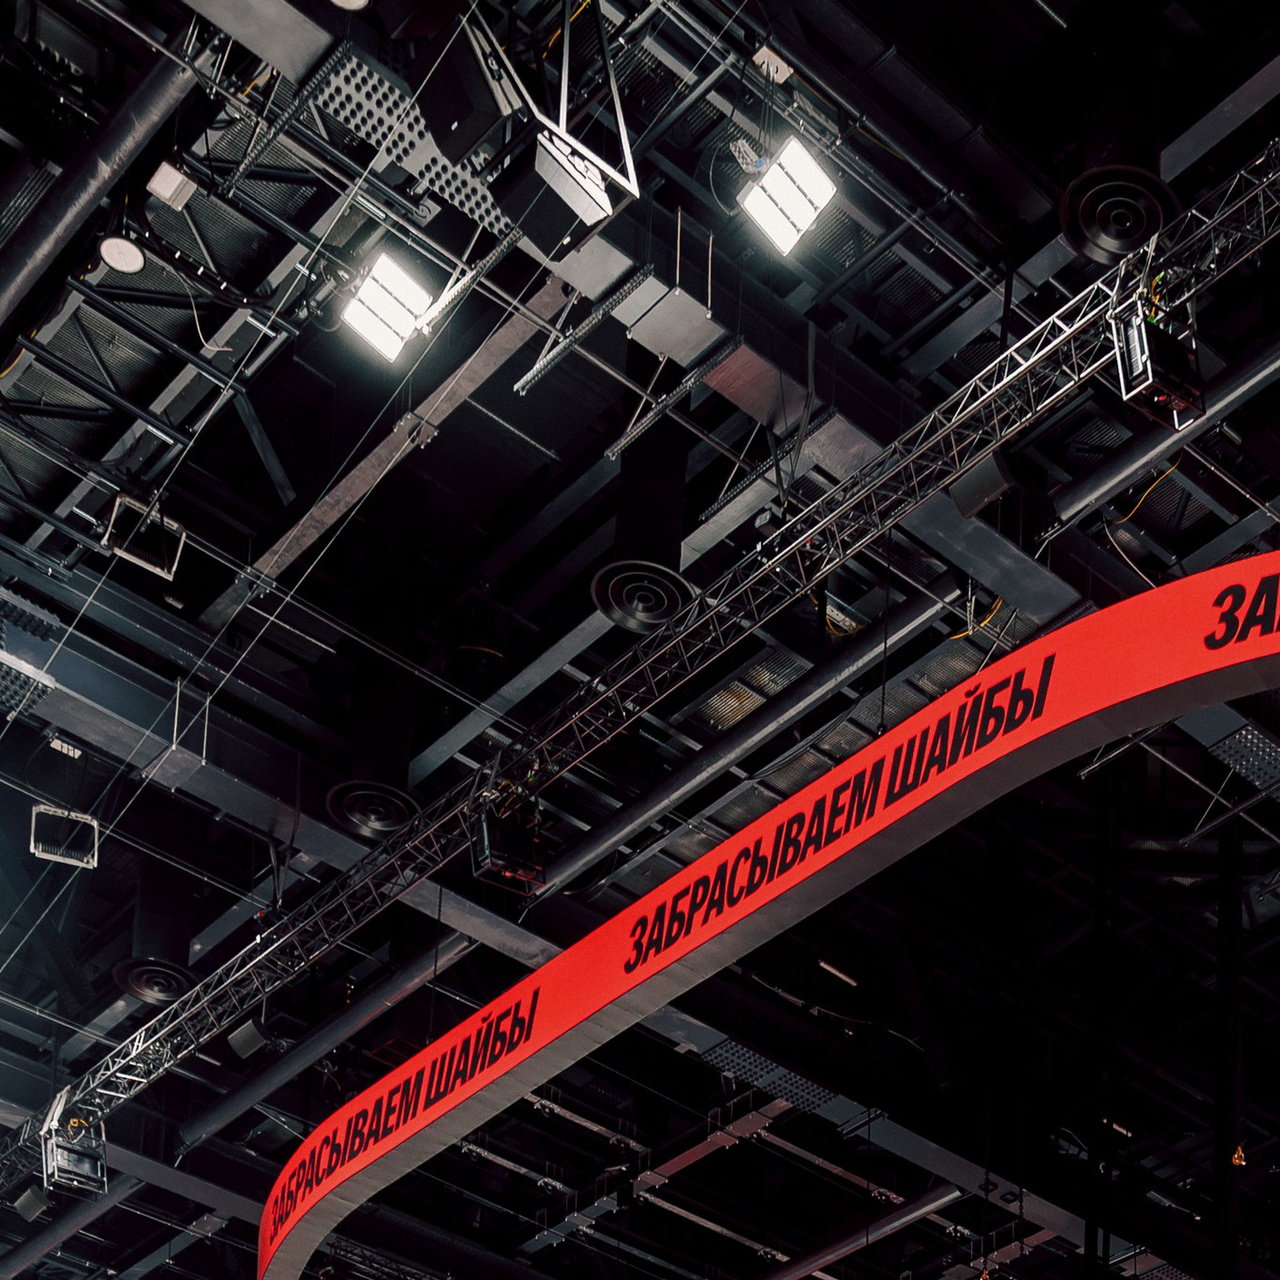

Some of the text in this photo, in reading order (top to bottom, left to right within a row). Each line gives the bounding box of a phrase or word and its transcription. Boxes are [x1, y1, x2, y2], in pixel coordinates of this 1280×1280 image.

[625, 655, 1057, 976] ЗАБРАСЫВАЕМ ШАЙБЫ
[270, 987, 541, 1247] ЗАБРАСЫВАЕМ ШАЙБЫ
